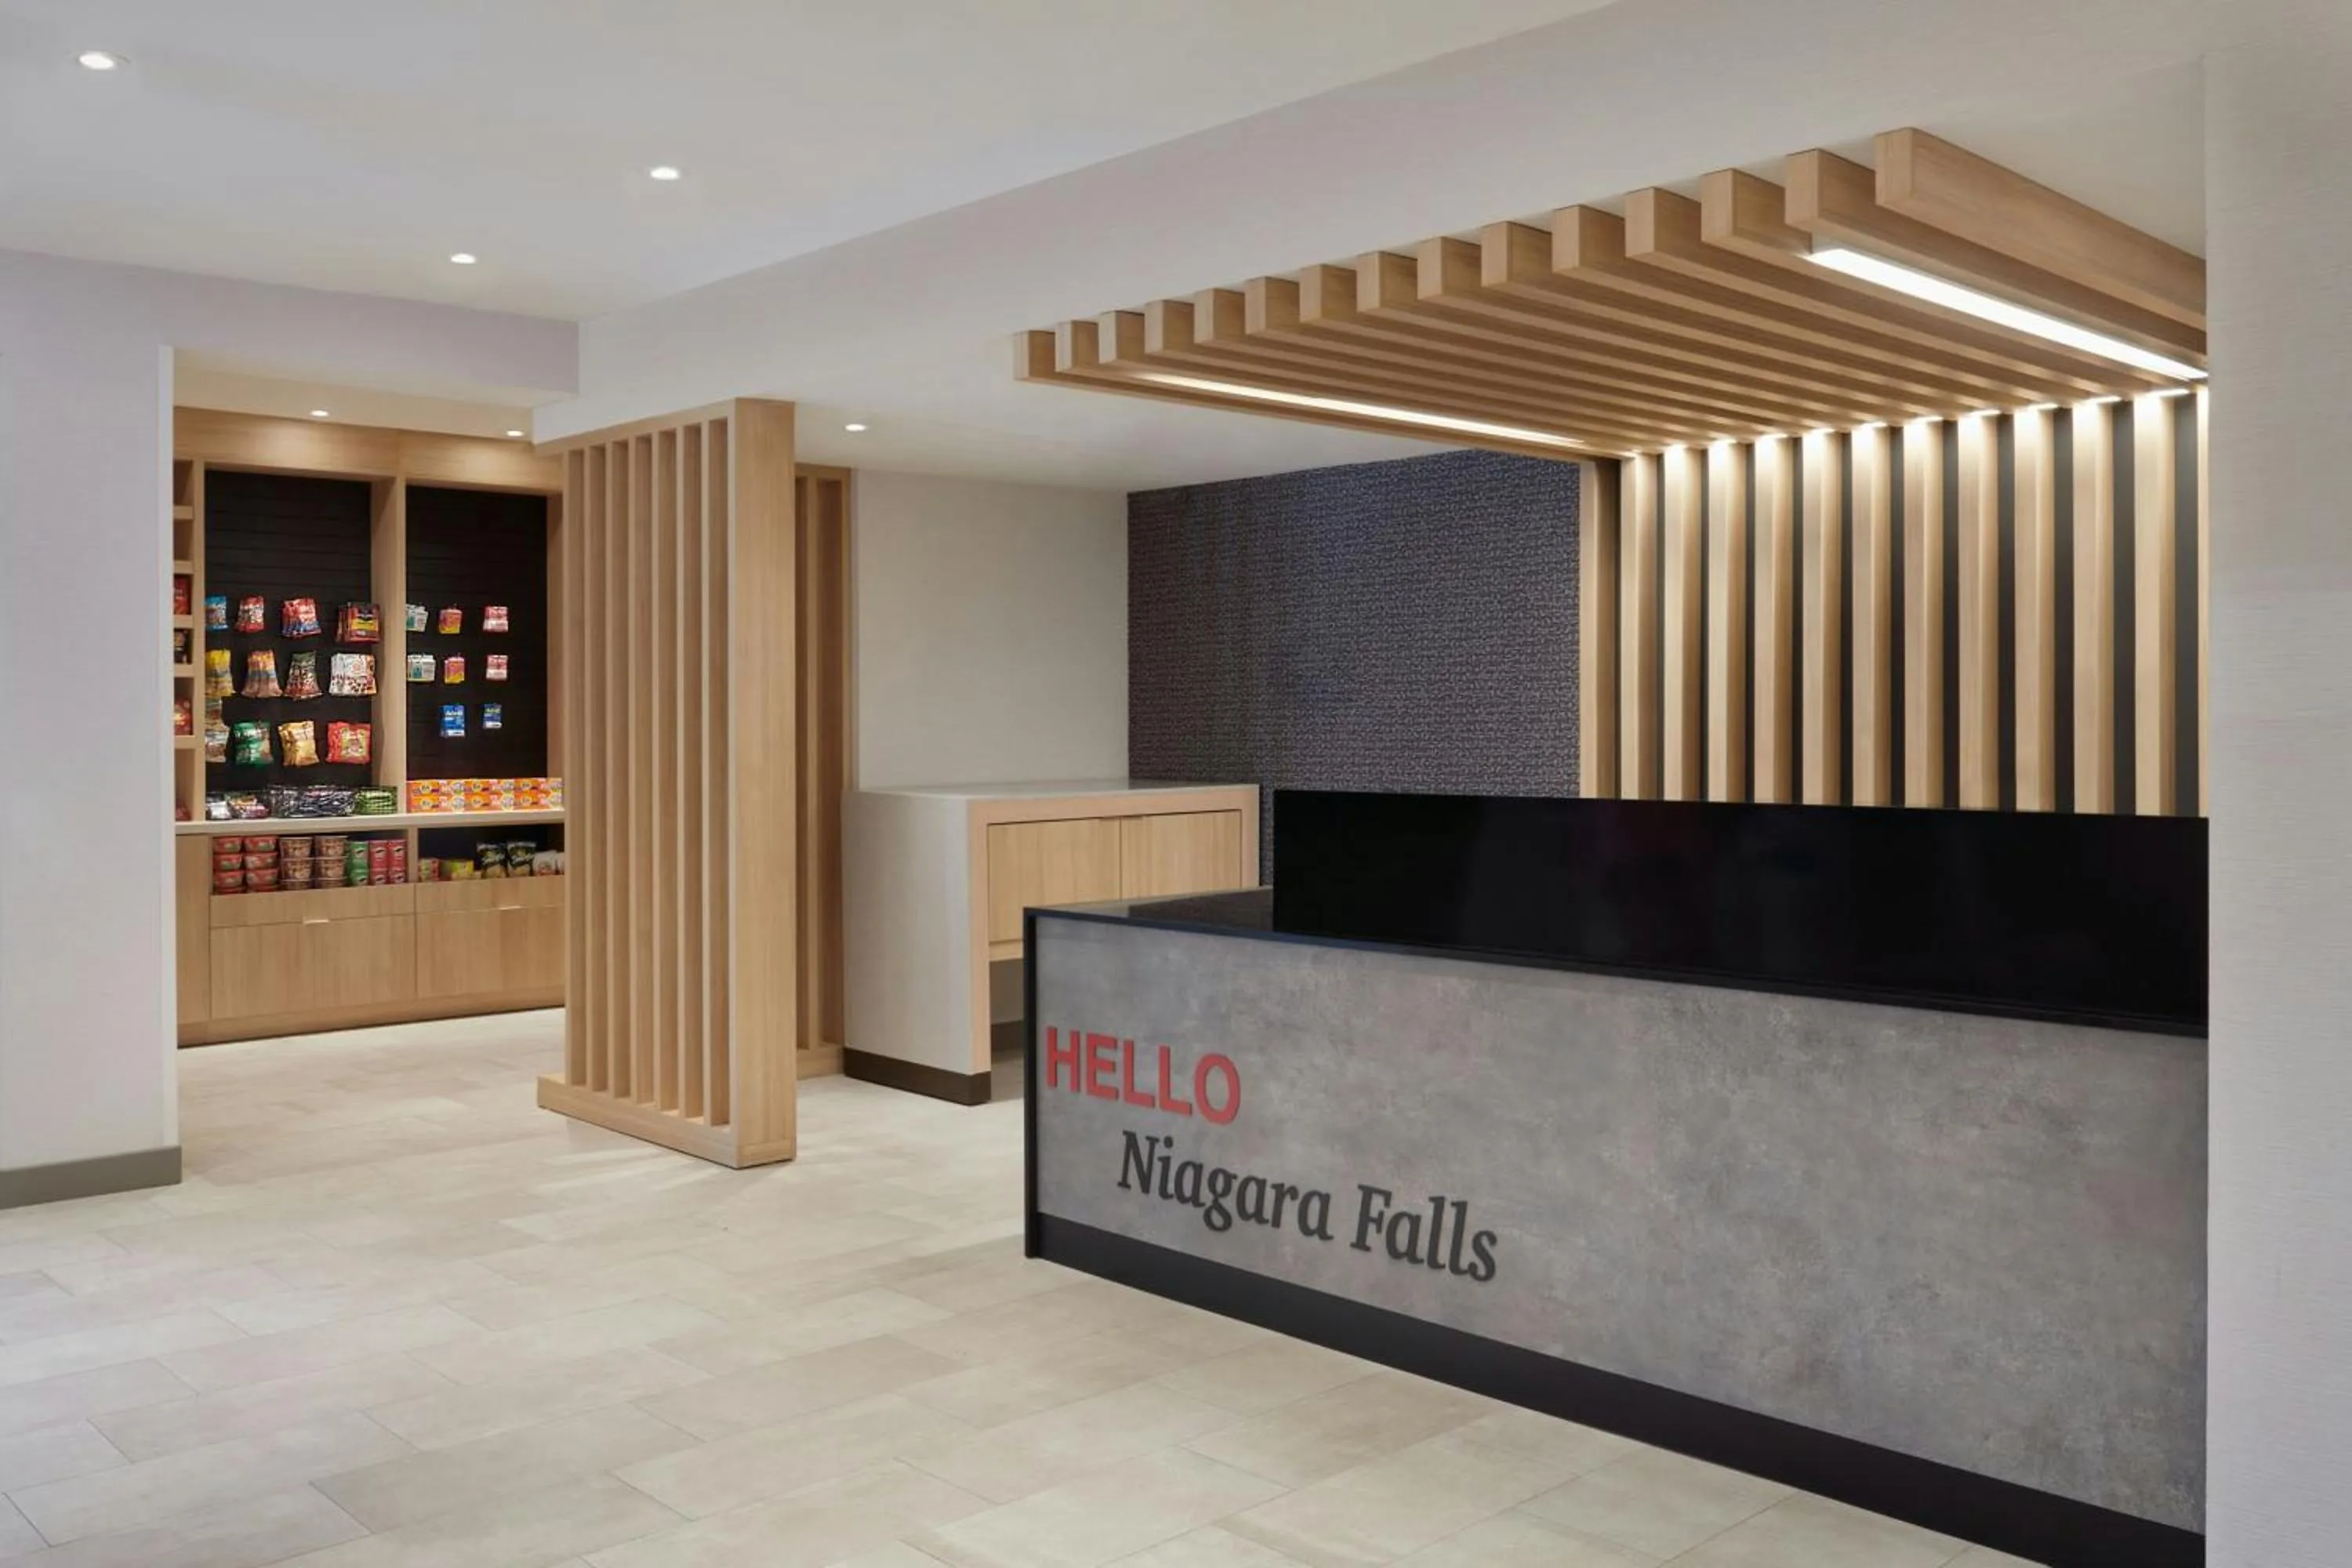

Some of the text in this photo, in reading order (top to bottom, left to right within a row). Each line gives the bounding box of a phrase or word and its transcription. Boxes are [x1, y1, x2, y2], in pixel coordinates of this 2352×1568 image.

[1046, 1026, 1240, 1124] HELLO
[1116, 1130, 1497, 1283] Niagara Falls
